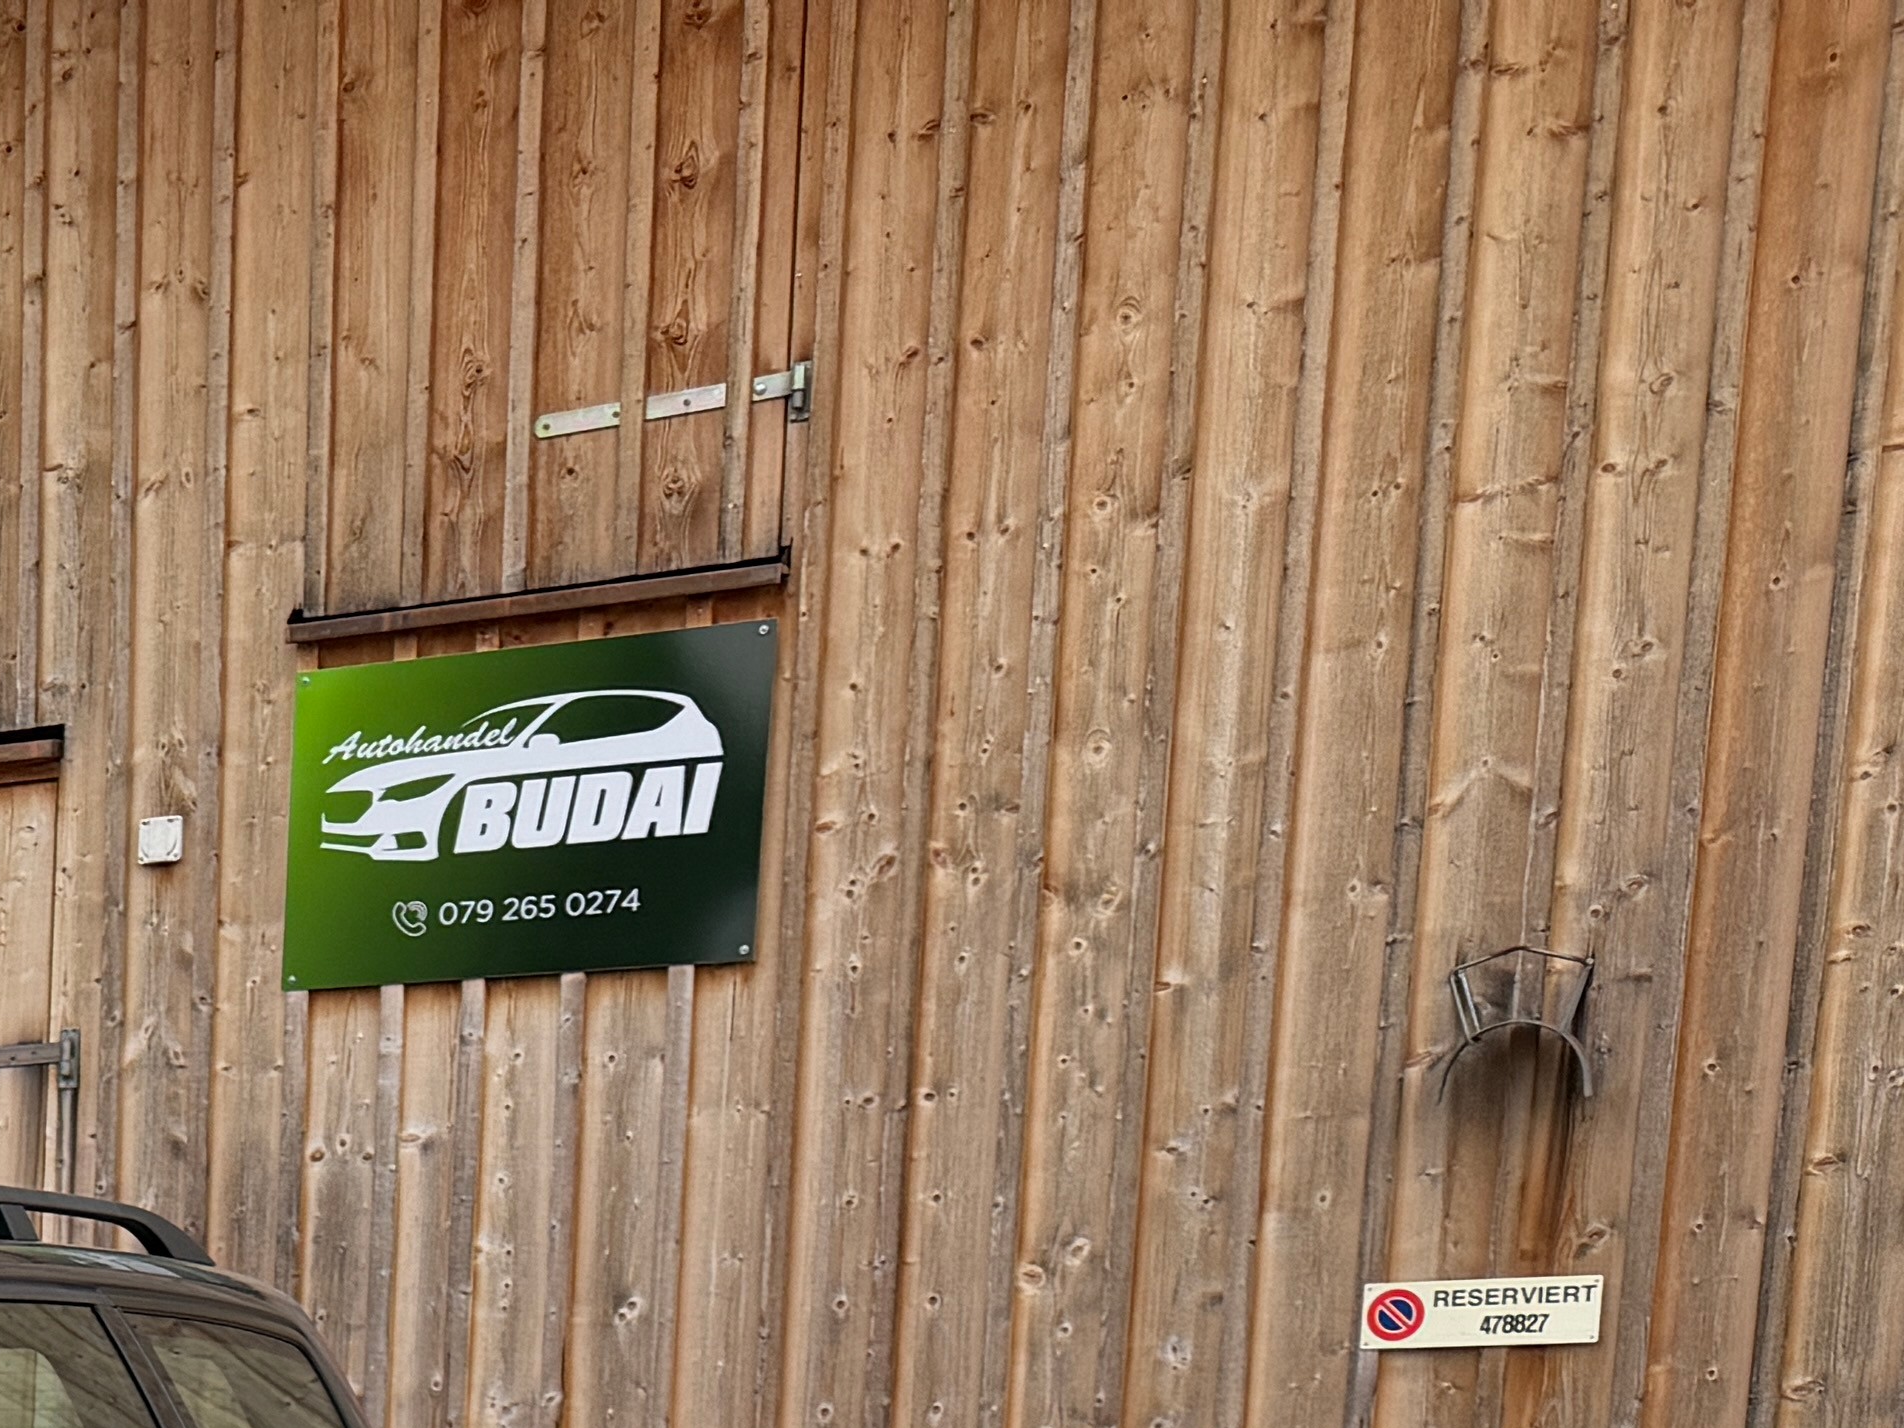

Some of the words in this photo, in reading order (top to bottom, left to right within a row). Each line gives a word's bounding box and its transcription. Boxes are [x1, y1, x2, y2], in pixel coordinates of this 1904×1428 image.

[322, 717, 517, 764] Autohandel
[453, 762, 724, 854] BUDAI
[439, 899, 494, 926] 079
[501, 894, 556, 921] 265
[565, 888, 641, 917] 0274
[1432, 1284, 1598, 1308] RESERVIERT
[1479, 1313, 1550, 1335] 478827
